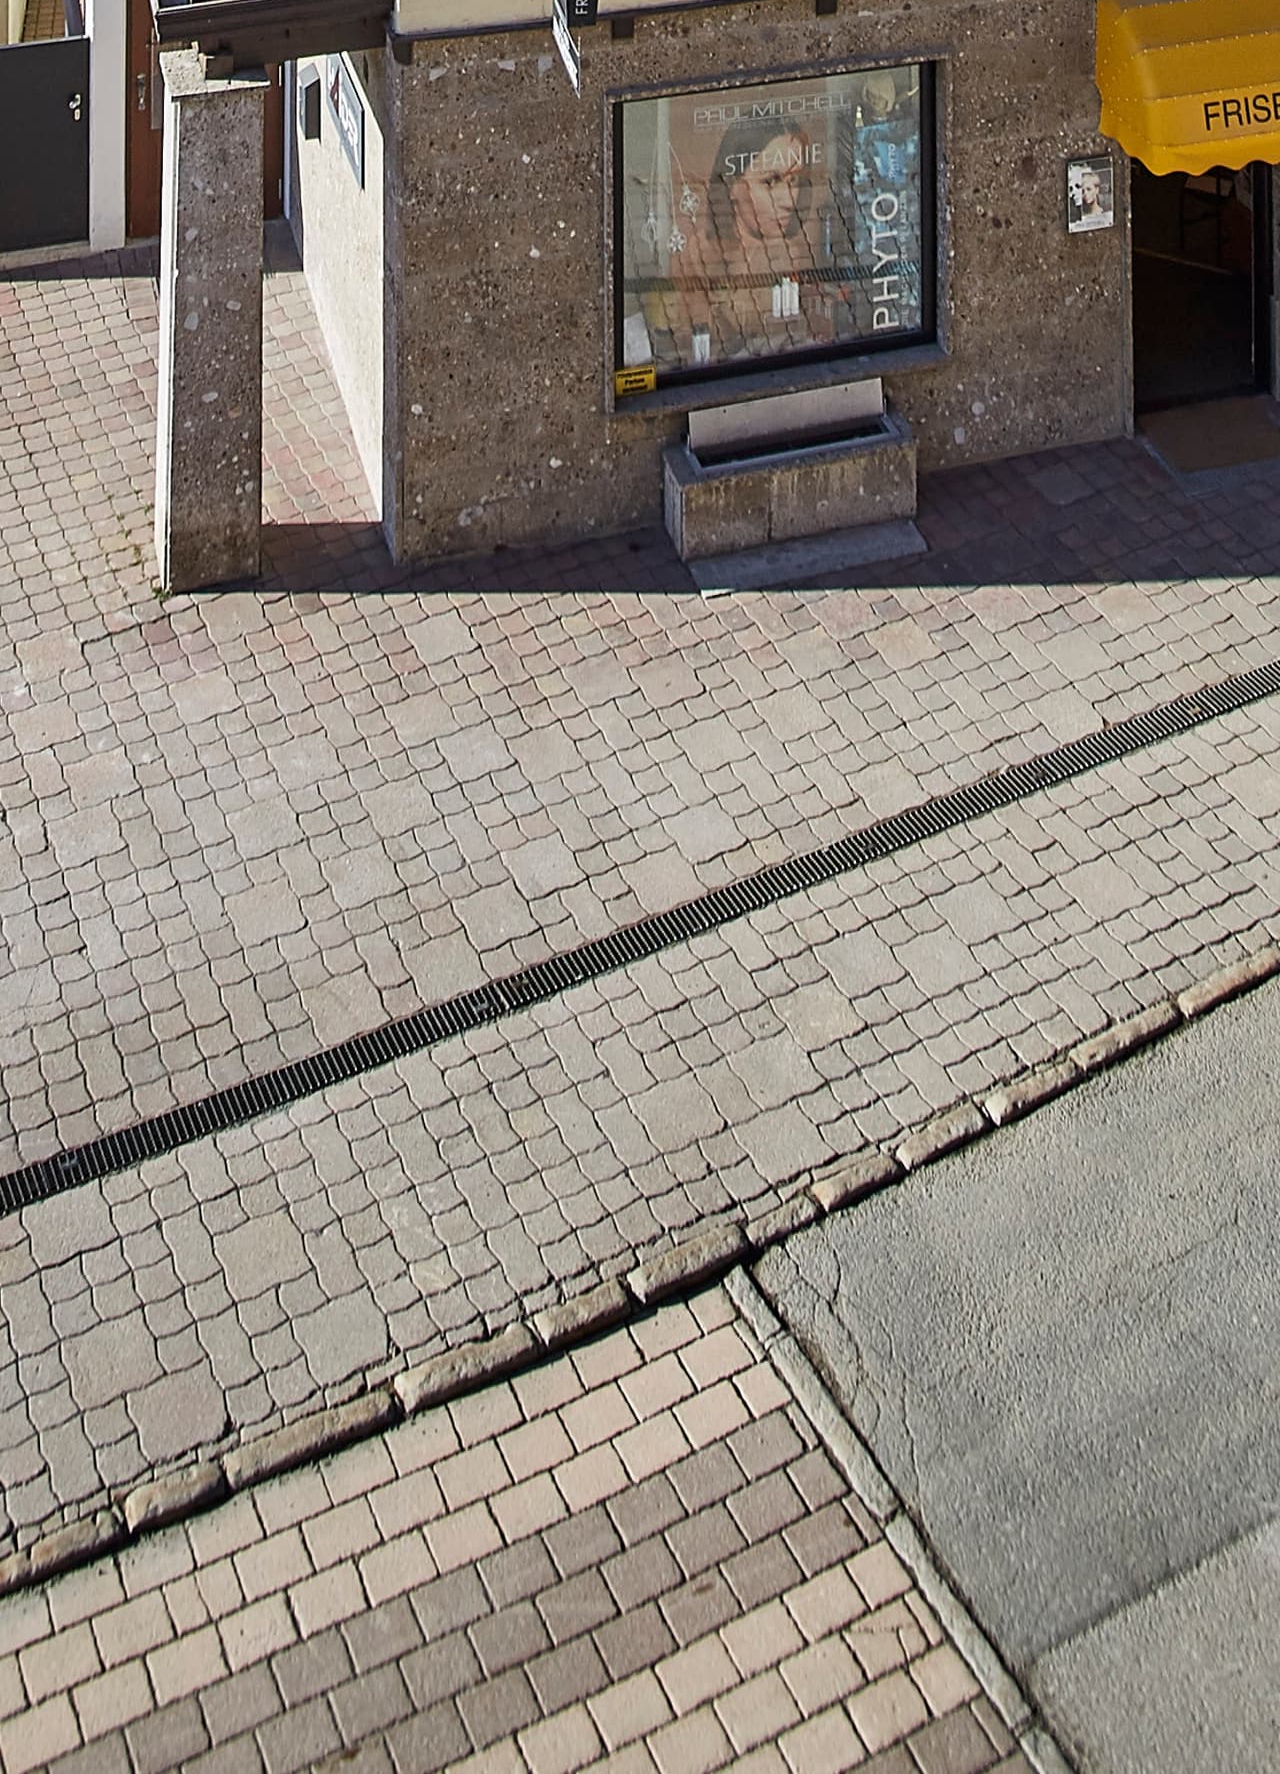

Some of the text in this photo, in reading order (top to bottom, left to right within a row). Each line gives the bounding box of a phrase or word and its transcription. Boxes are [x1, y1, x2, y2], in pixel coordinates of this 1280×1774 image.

[694, 105, 749, 125] PAUL
[752, 93, 851, 117] MITCHELL
[724, 142, 823, 176] STEFANIE
[872, 193, 900, 330] PHYTO
